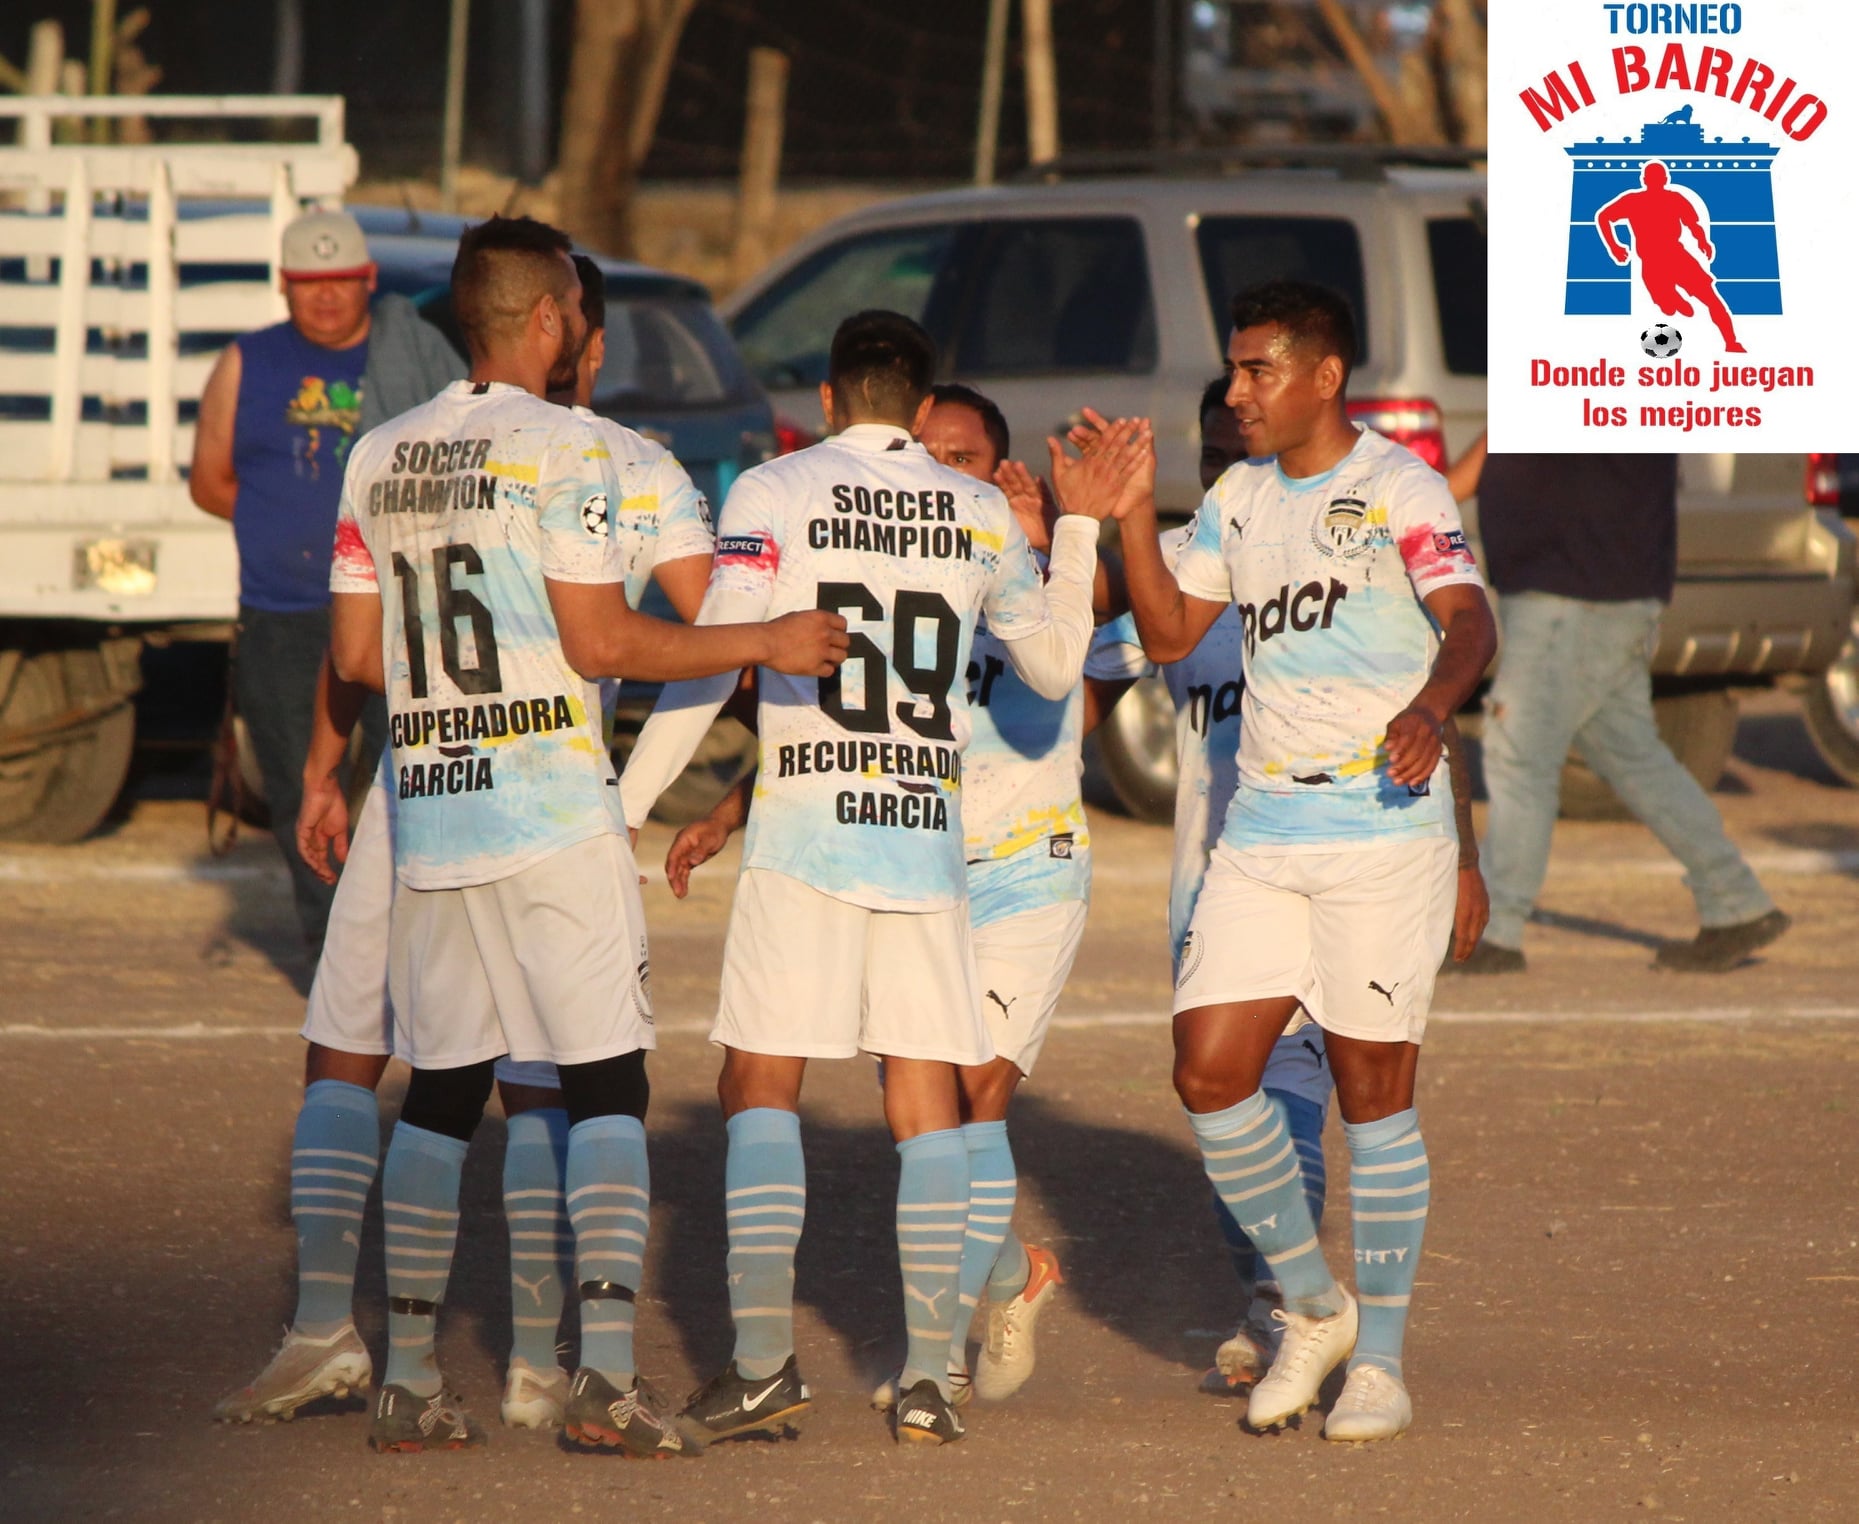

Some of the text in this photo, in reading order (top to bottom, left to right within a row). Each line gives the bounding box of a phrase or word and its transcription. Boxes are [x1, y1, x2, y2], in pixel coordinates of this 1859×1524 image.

[391, 438, 492, 475] SOCCER
[368, 474, 497, 517] CHAMPION
[832, 484, 956, 522] SOCCER
[719, 540, 761, 552] RESPECT
[808, 518, 972, 561] CHAMPION
[391, 543, 502, 699] 16
[816, 582, 961, 742] 69
[399, 757, 494, 800] GARCIA
[778, 740, 961, 786] RECUPERADO
[836, 790, 947, 832] GARCIA
[1354, 1247, 1408, 1264] CITY
[903, 1408, 937, 1428] NIKE
